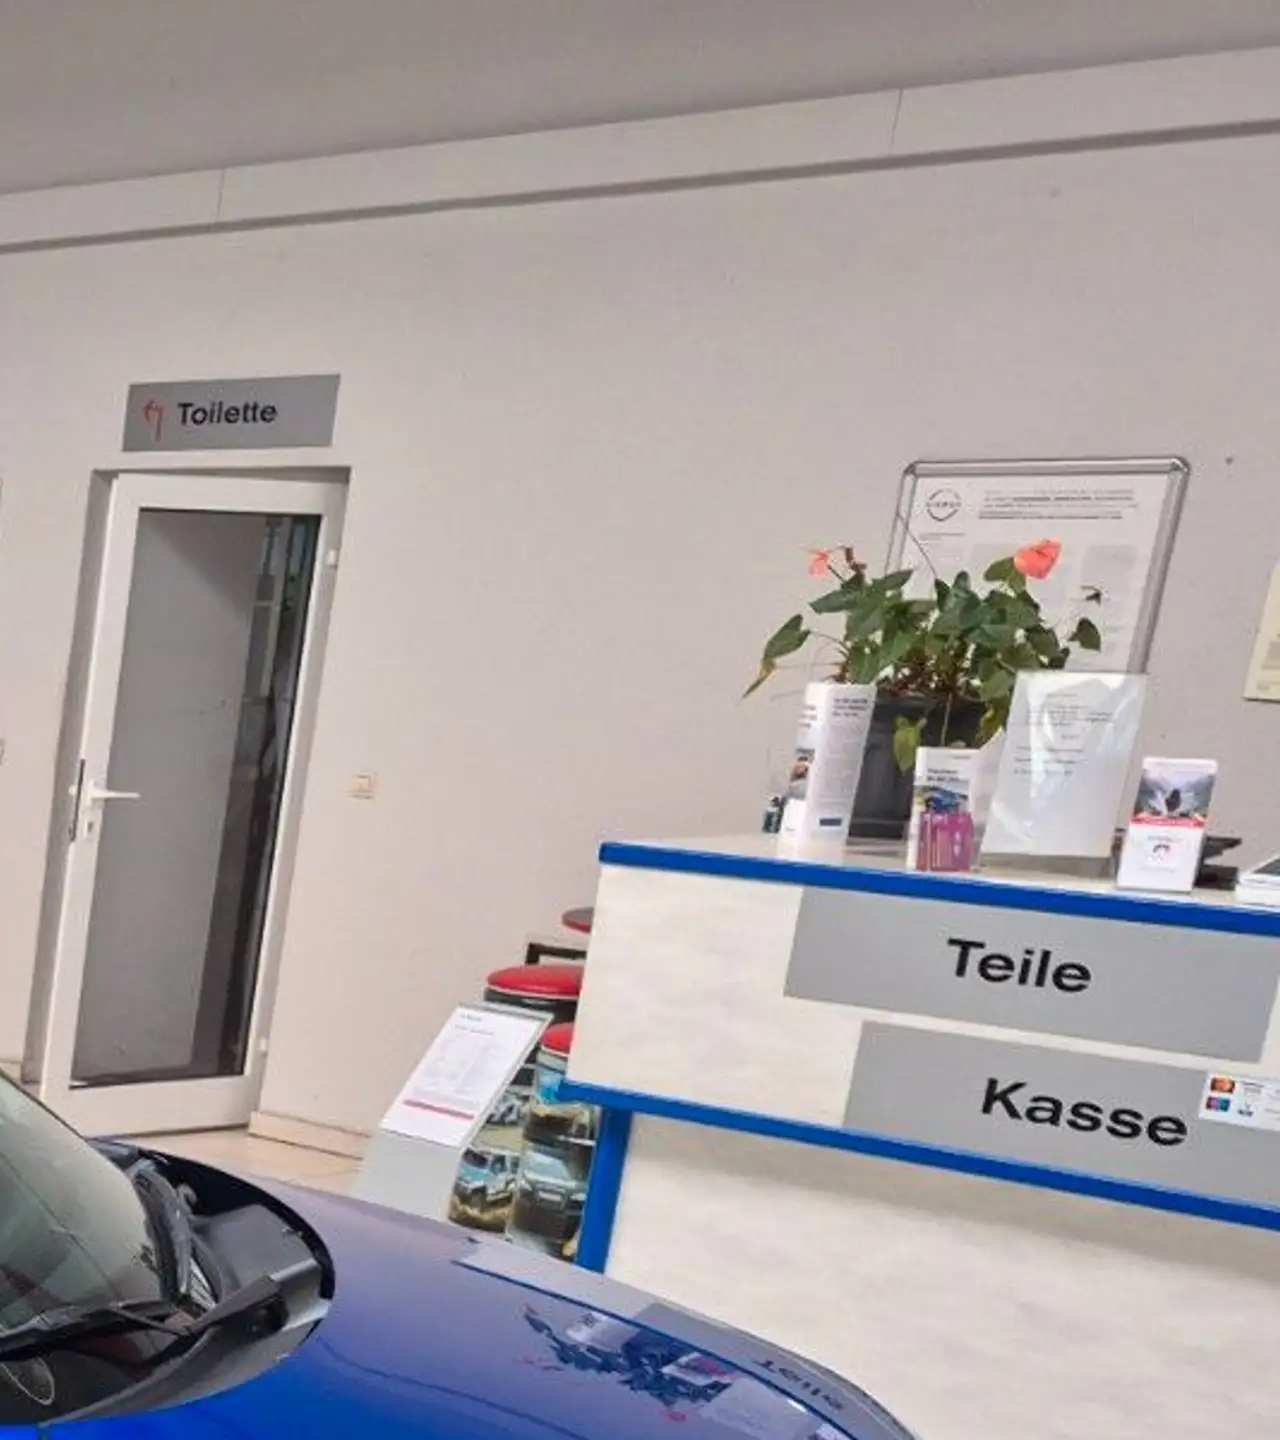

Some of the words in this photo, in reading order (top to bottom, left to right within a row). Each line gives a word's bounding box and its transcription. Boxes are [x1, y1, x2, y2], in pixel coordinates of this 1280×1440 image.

[177, 401, 277, 426] Toilette
[947, 937, 1092, 993] Teile
[981, 1077, 1188, 1146] Kasse
